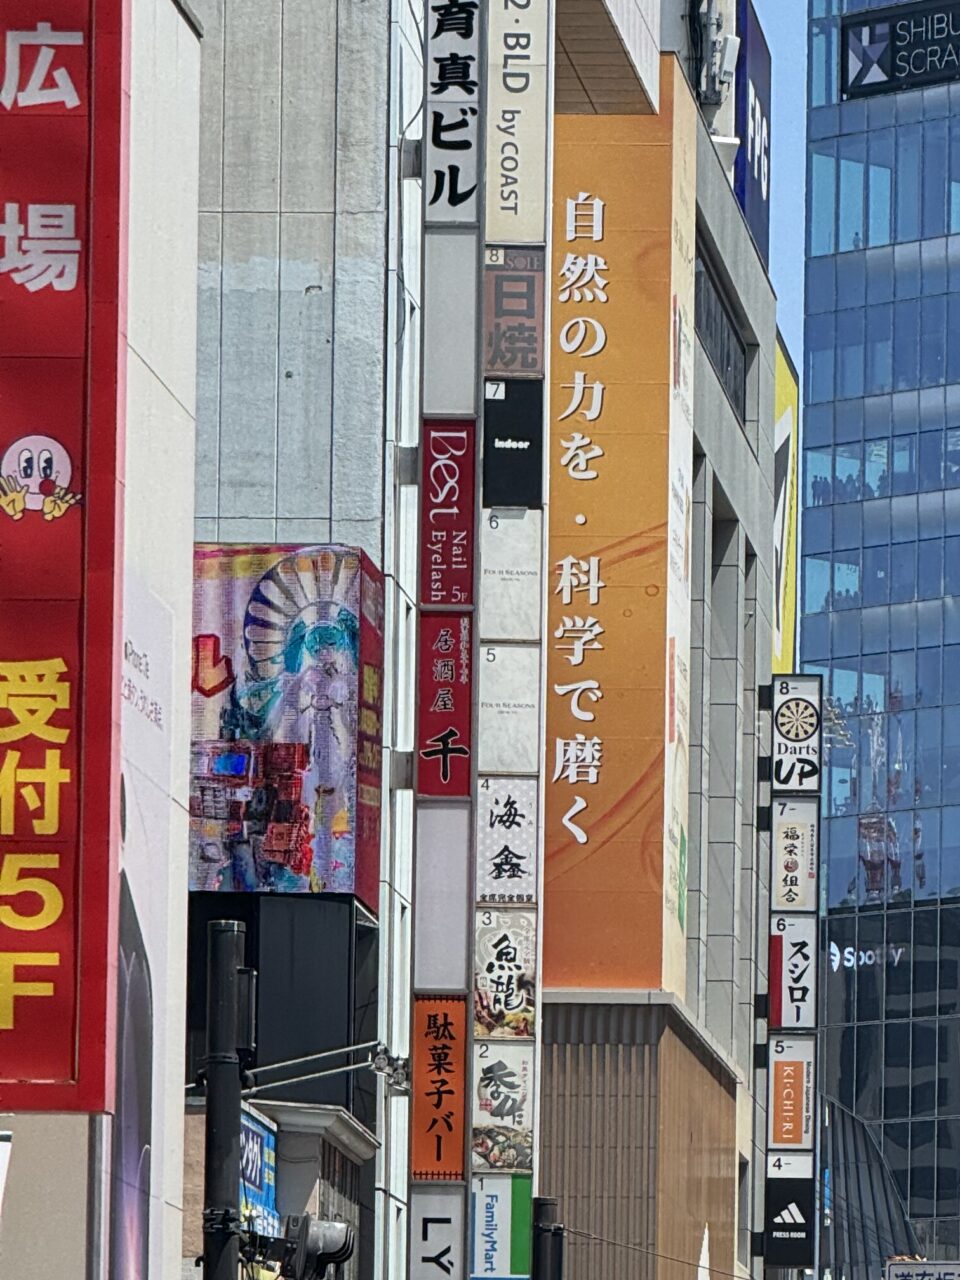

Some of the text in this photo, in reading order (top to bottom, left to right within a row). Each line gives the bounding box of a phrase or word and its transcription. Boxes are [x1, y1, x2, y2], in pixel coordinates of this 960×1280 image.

[496, 109, 521, 137] by
[746, 78, 769, 200] FPG
[499, 141, 519, 216] COAST
[489, 250, 499, 262] 8
[487, 275, 538, 369] 日焼
[491, 383, 500, 397] 7
[429, 430, 468, 524] Best
[489, 515, 499, 529] 6
[452, 530, 467, 569] Nail
[427, 530, 447, 602] Eyelash
[451, 586, 468, 602] 5F
[432, 628, 456, 713] 居酒屋
[486, 648, 497, 663] 5
[420, 727, 471, 784] 千
[776, 742, 818, 756] Darts
[481, 779, 490, 791] 4
[774, 757, 819, 787] UP
[481, 911, 492, 926] 3
[787, 940, 810, 1024] スシロー
[479, 1044, 489, 1058] 2
[424, 1013, 457, 1162] 駄菓子バー
[478, 1177, 484, 1191] 1
[482, 1194, 499, 1273] FamilyMart
